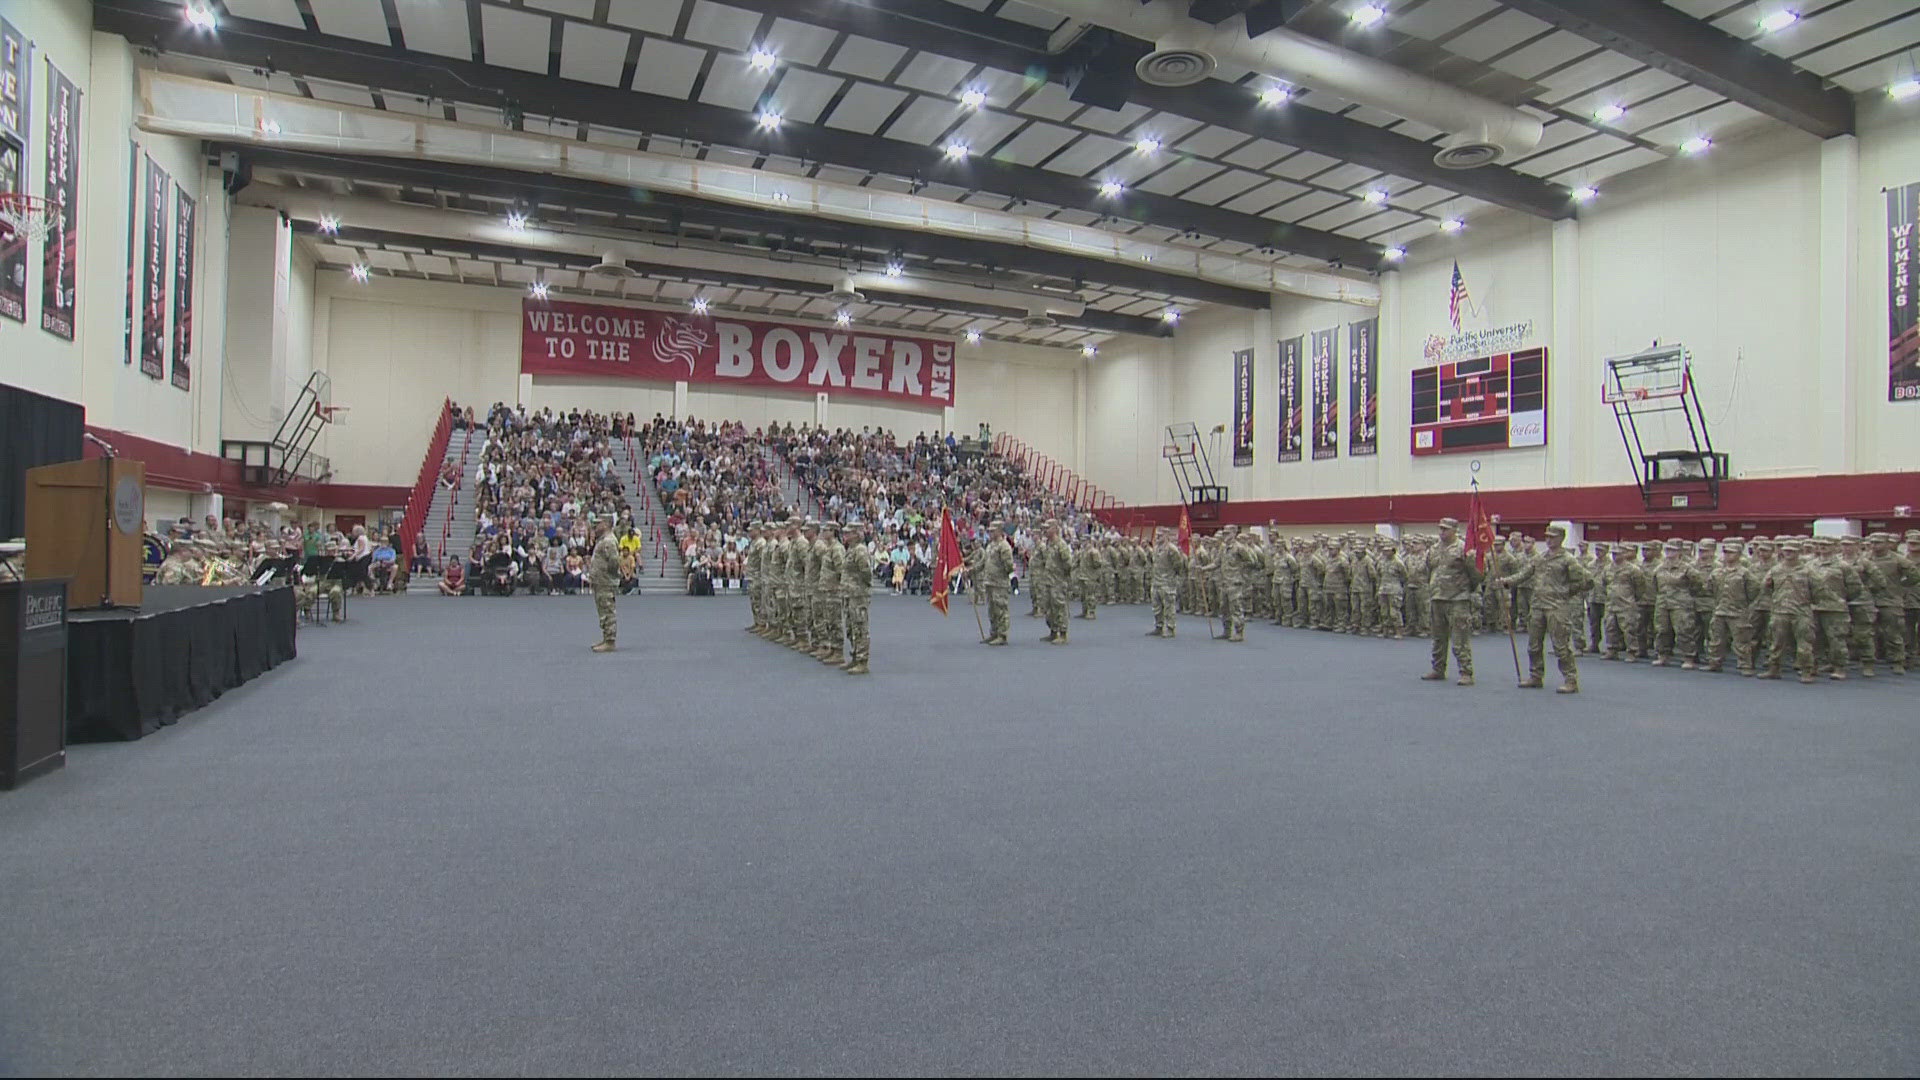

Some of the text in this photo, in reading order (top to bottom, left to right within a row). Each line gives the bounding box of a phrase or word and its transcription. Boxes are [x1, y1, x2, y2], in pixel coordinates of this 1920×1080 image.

[4, 35, 18, 207] TENNI
[56, 213, 66, 308] FIELD
[152, 173, 161, 356] VOLLEYB
[1892, 223, 1912, 306] WOMEN'S
[528, 311, 645, 339] WELCOME
[546, 337, 629, 362] TO THE
[715, 321, 923, 396] BOXER
[1450, 322, 1527, 345] Pacific University
[931, 344, 950, 400] DEN
[1321, 337, 1329, 447] BASKETBALL
[27, 595, 62, 614] PACIFIC
